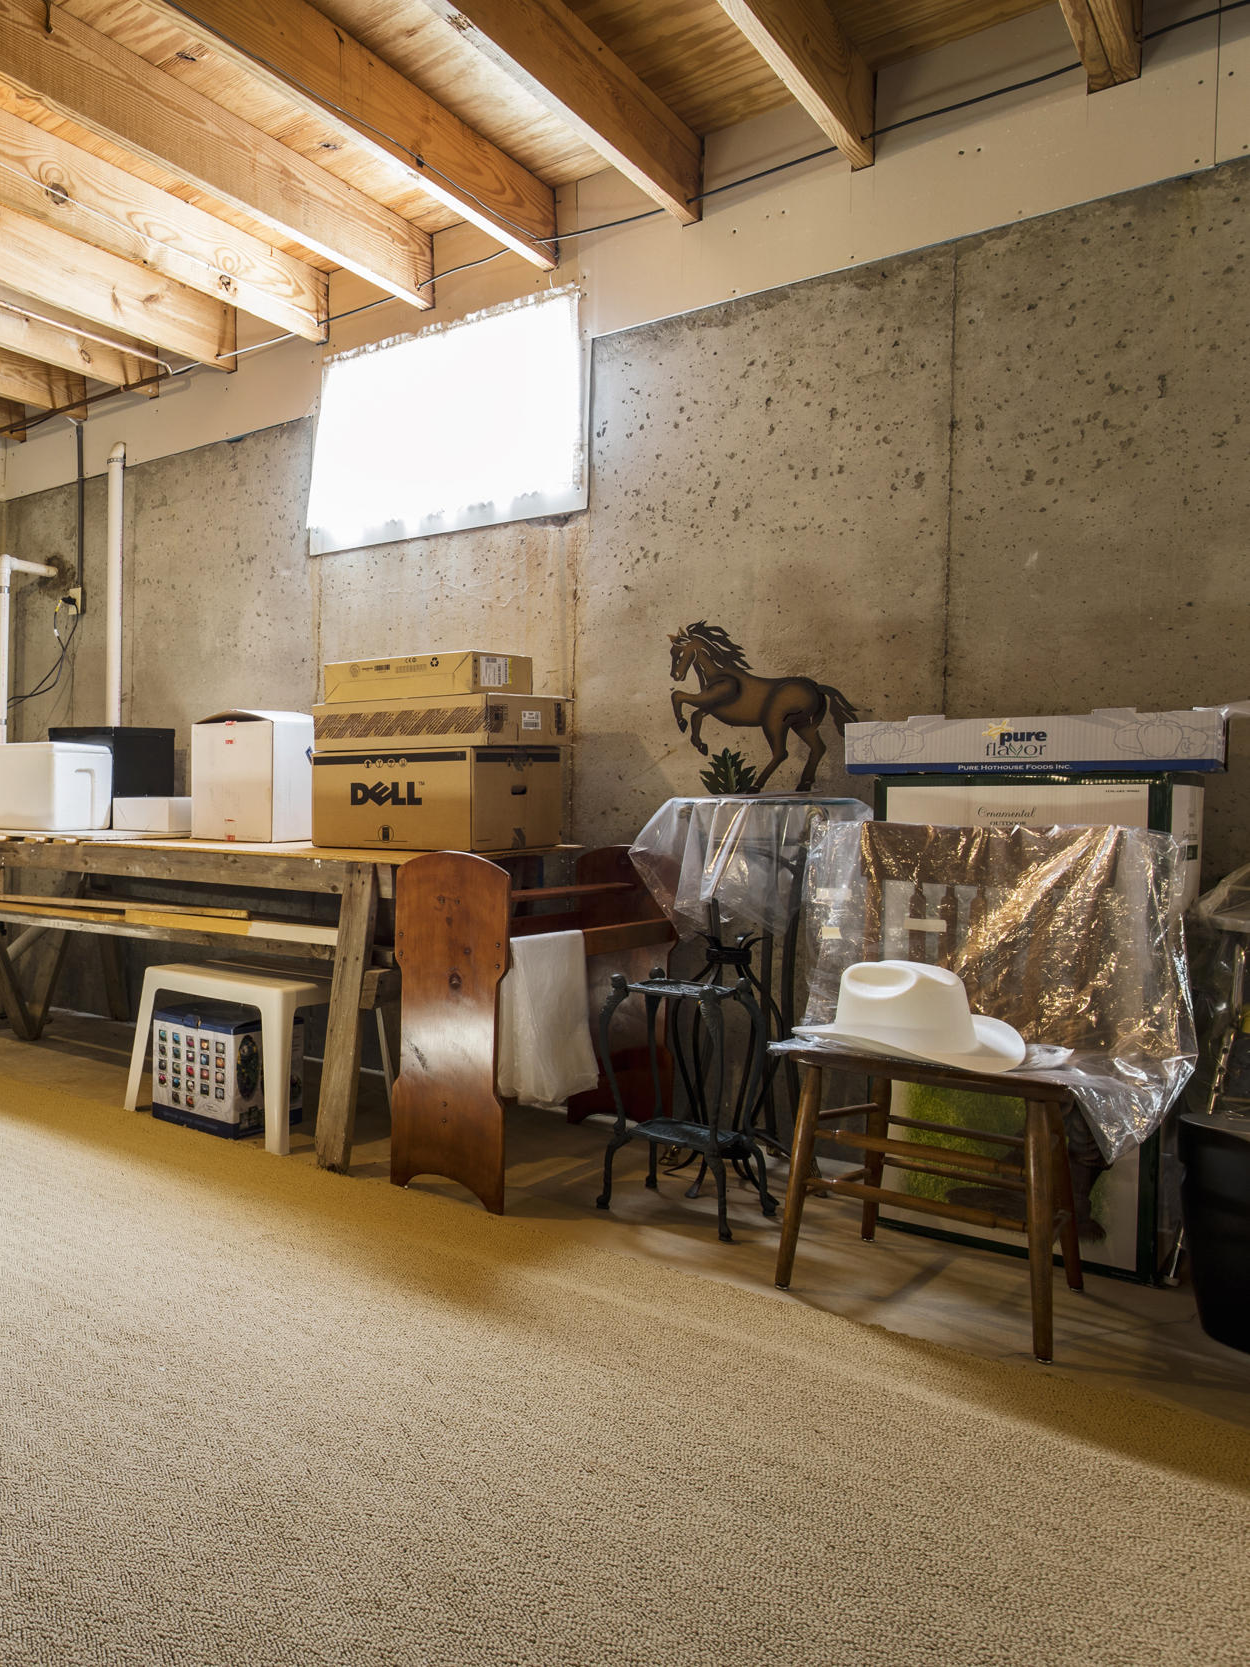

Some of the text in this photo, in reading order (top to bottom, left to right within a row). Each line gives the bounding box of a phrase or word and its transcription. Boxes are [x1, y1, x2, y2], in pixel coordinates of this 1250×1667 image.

[1000, 730, 1047, 746] pure
[985, 743, 1047, 757] flavor
[980, 763, 1025, 771] HOTHOUSE
[1025, 763, 1054, 771] FOODS
[350, 781, 423, 806] DELL
[977, 805, 1038, 819] Ornamental
